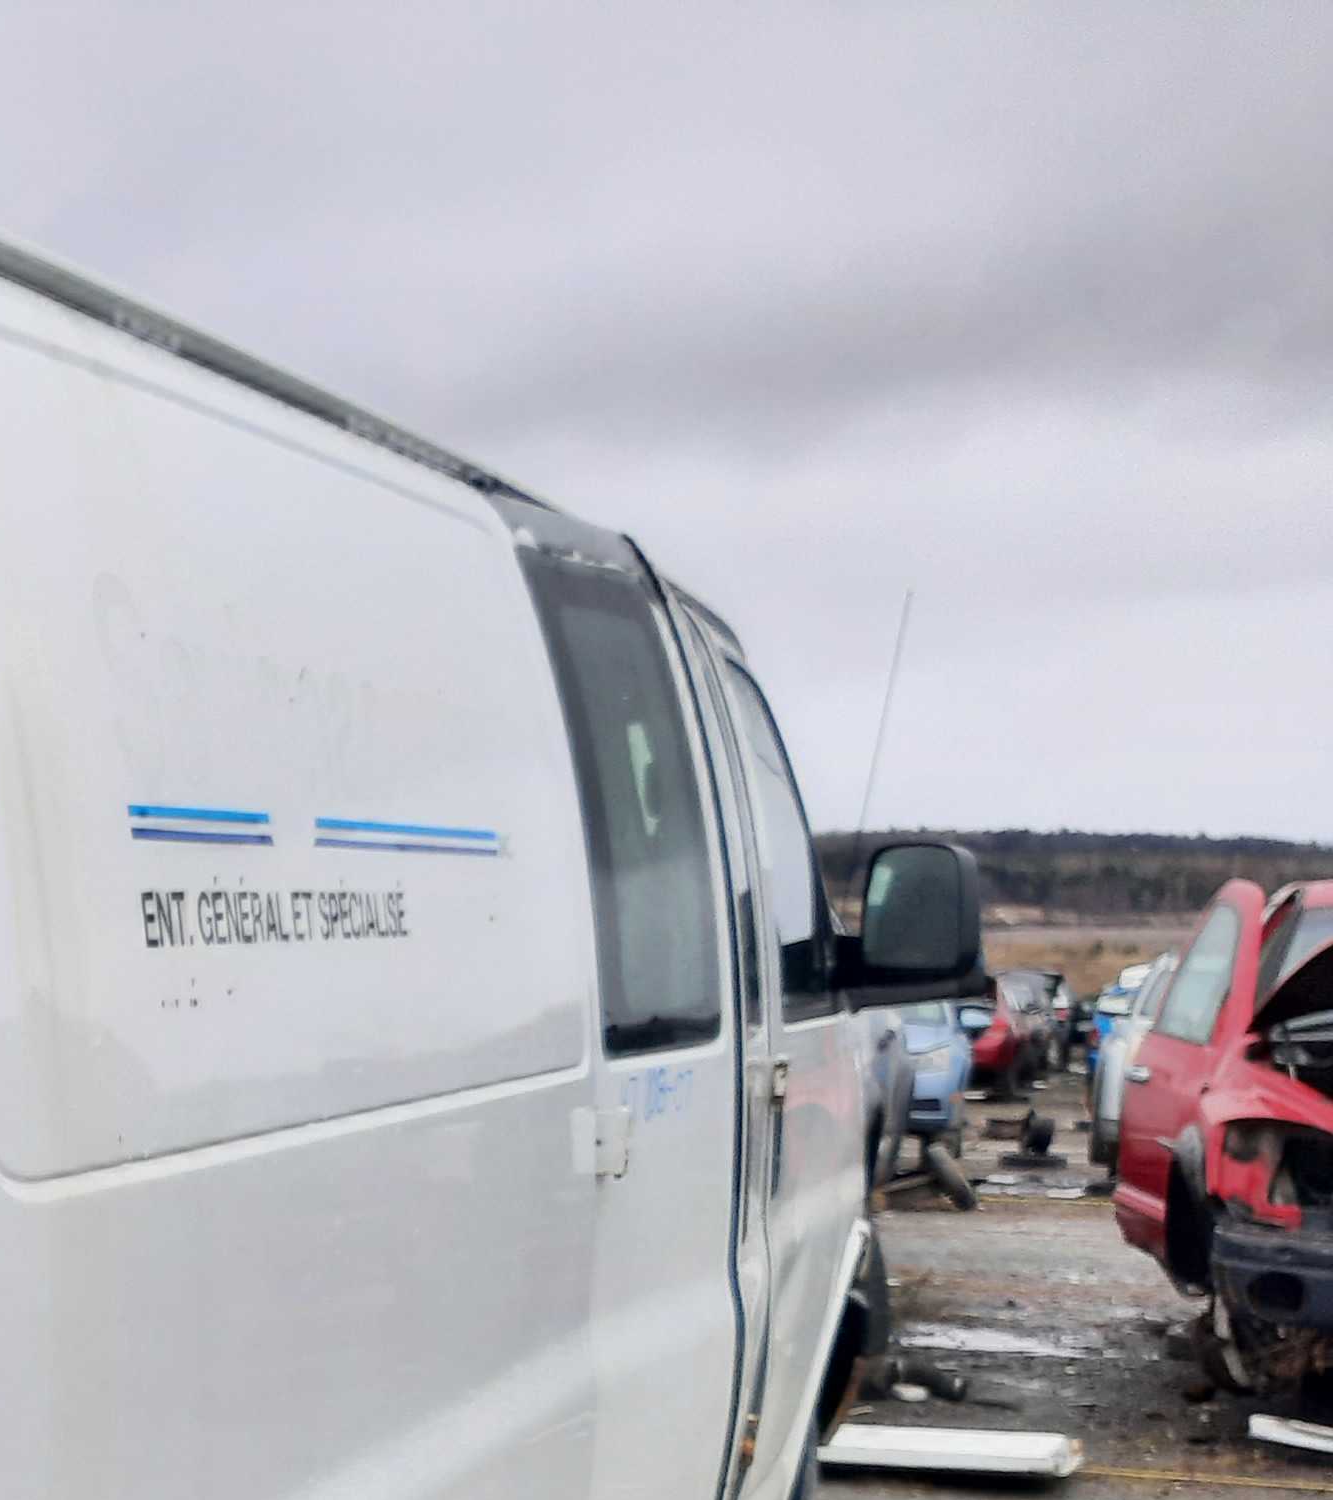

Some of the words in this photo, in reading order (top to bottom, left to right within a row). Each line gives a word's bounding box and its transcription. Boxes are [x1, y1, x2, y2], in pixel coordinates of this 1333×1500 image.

[141, 890, 194, 947] ENT.
[197, 876, 290, 946] GÉNÉRAL
[291, 891, 312, 940] ET
